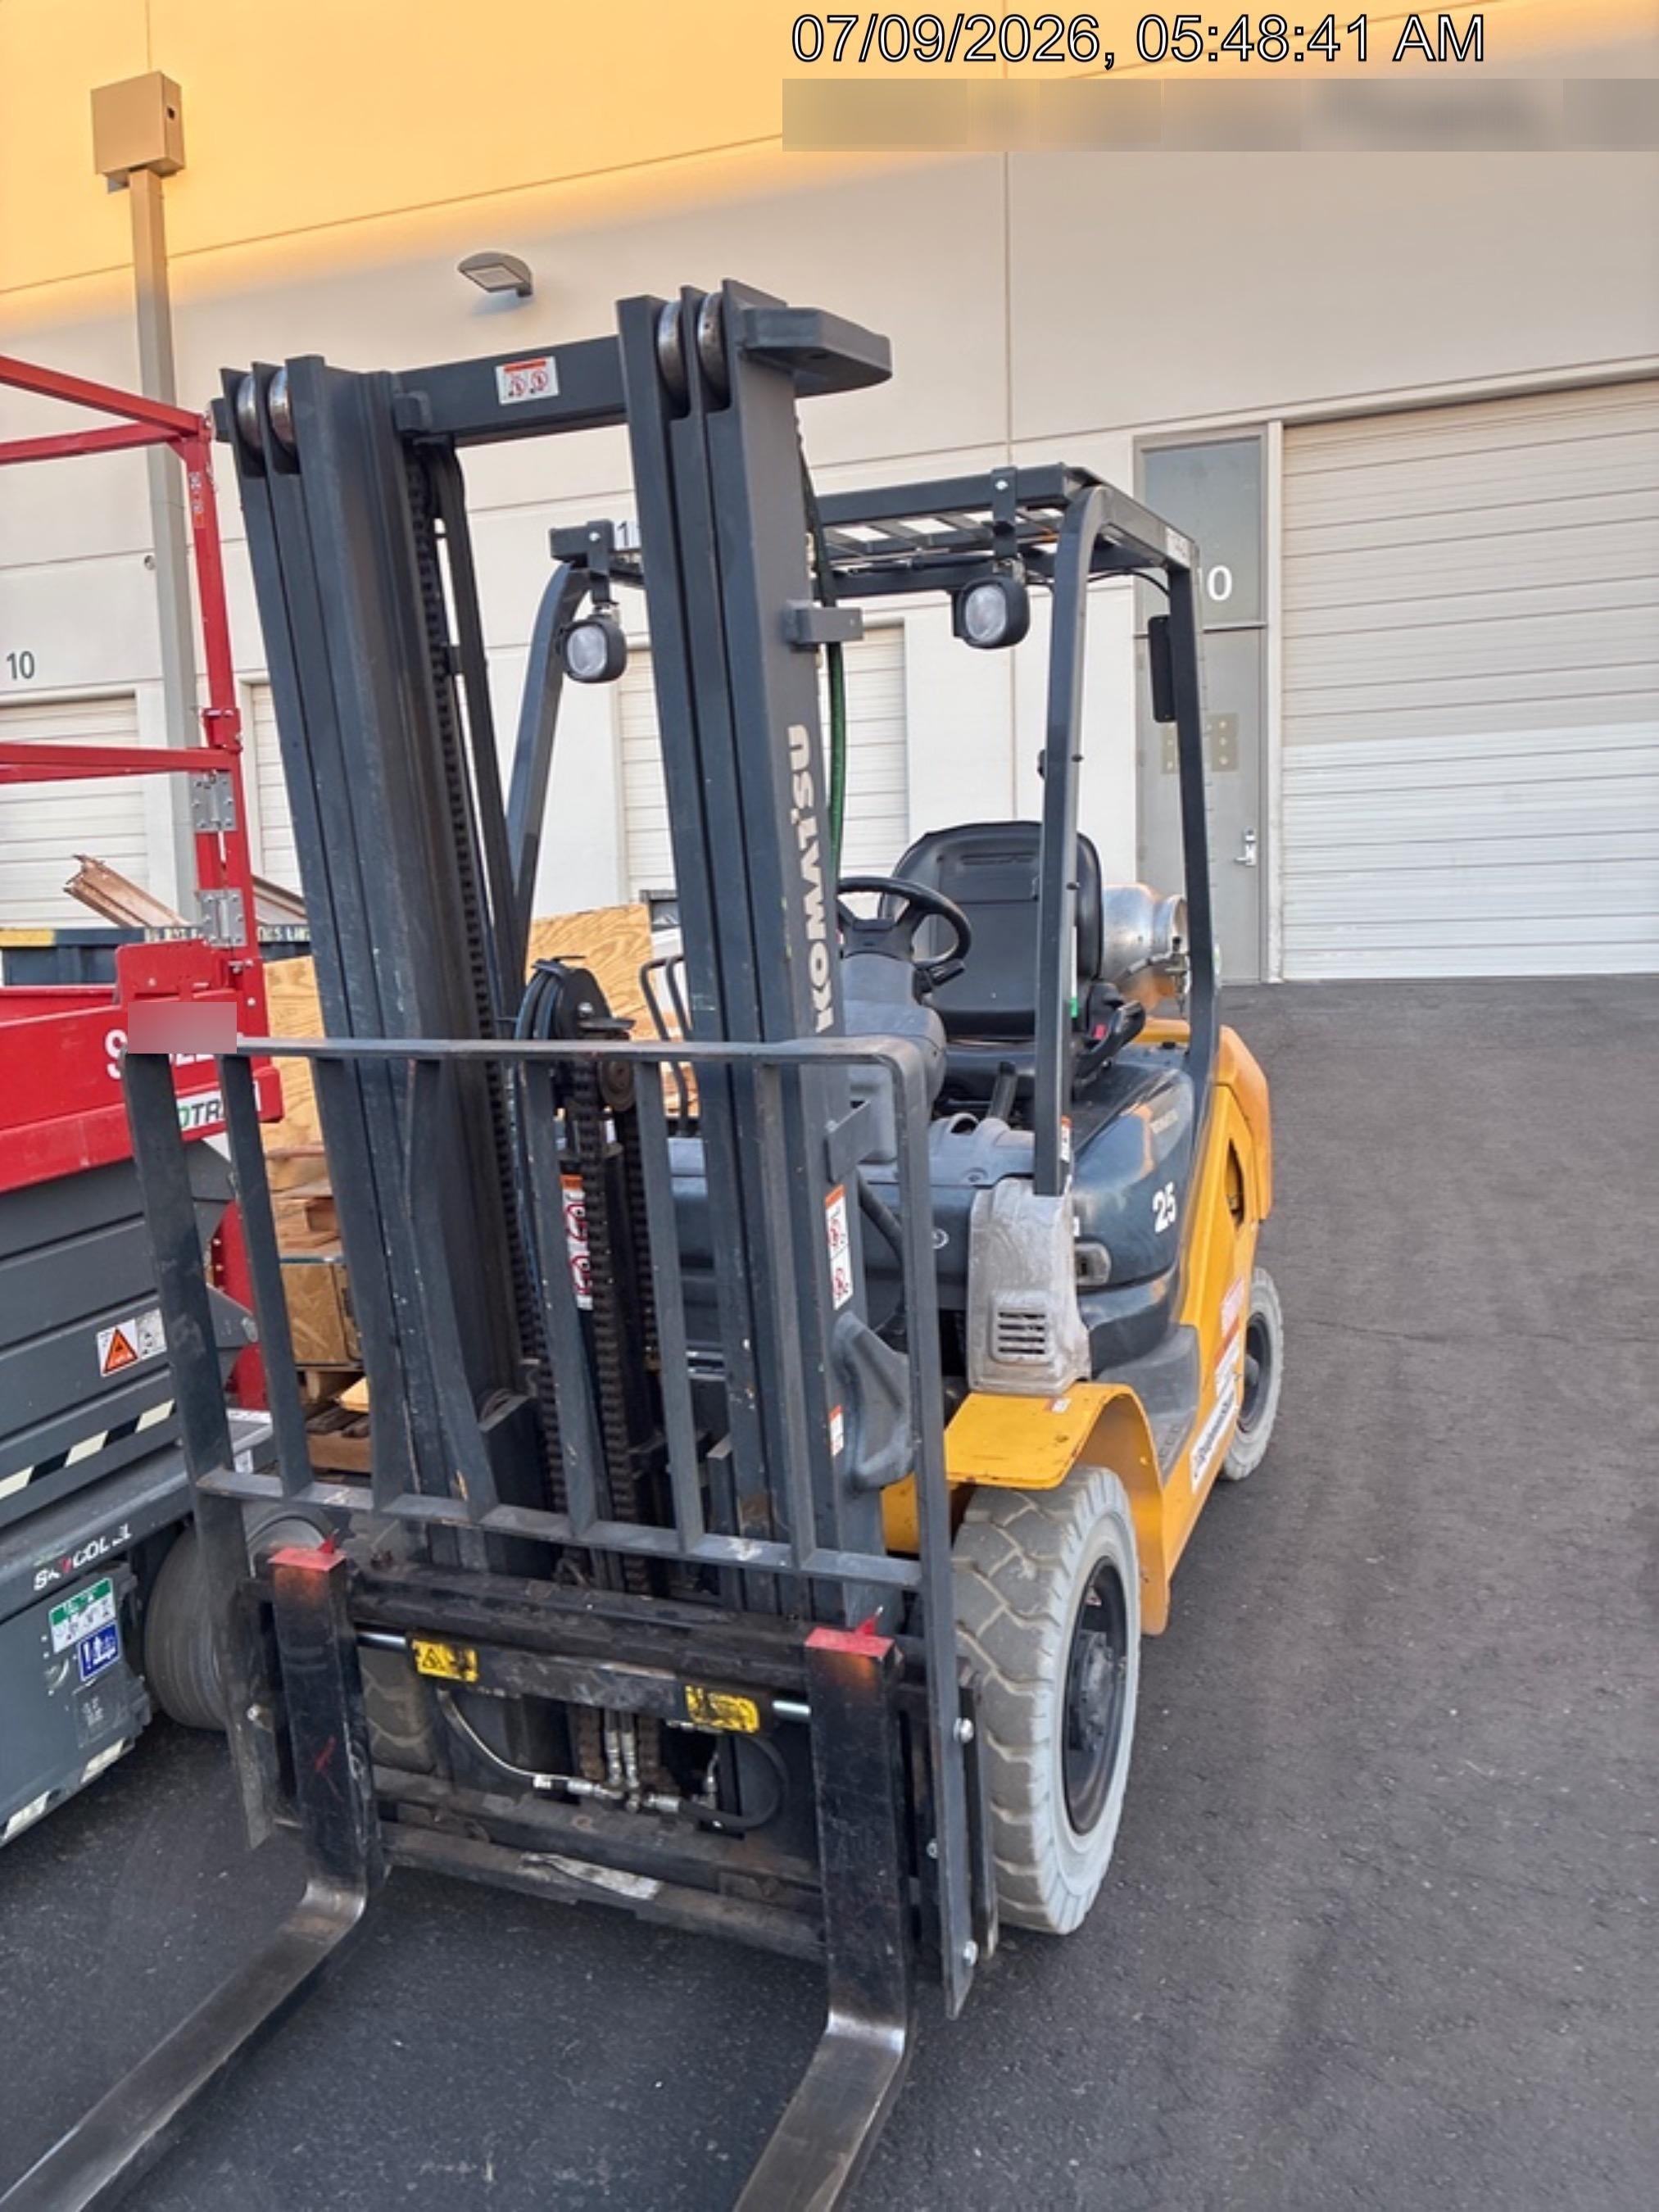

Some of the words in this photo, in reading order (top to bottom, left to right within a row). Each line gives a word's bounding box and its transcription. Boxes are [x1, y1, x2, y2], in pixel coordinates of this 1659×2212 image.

[7, 650, 35, 680] 10
[787, 723, 835, 1034] KOMATSU
[1152, 1181, 1177, 1233] 25
